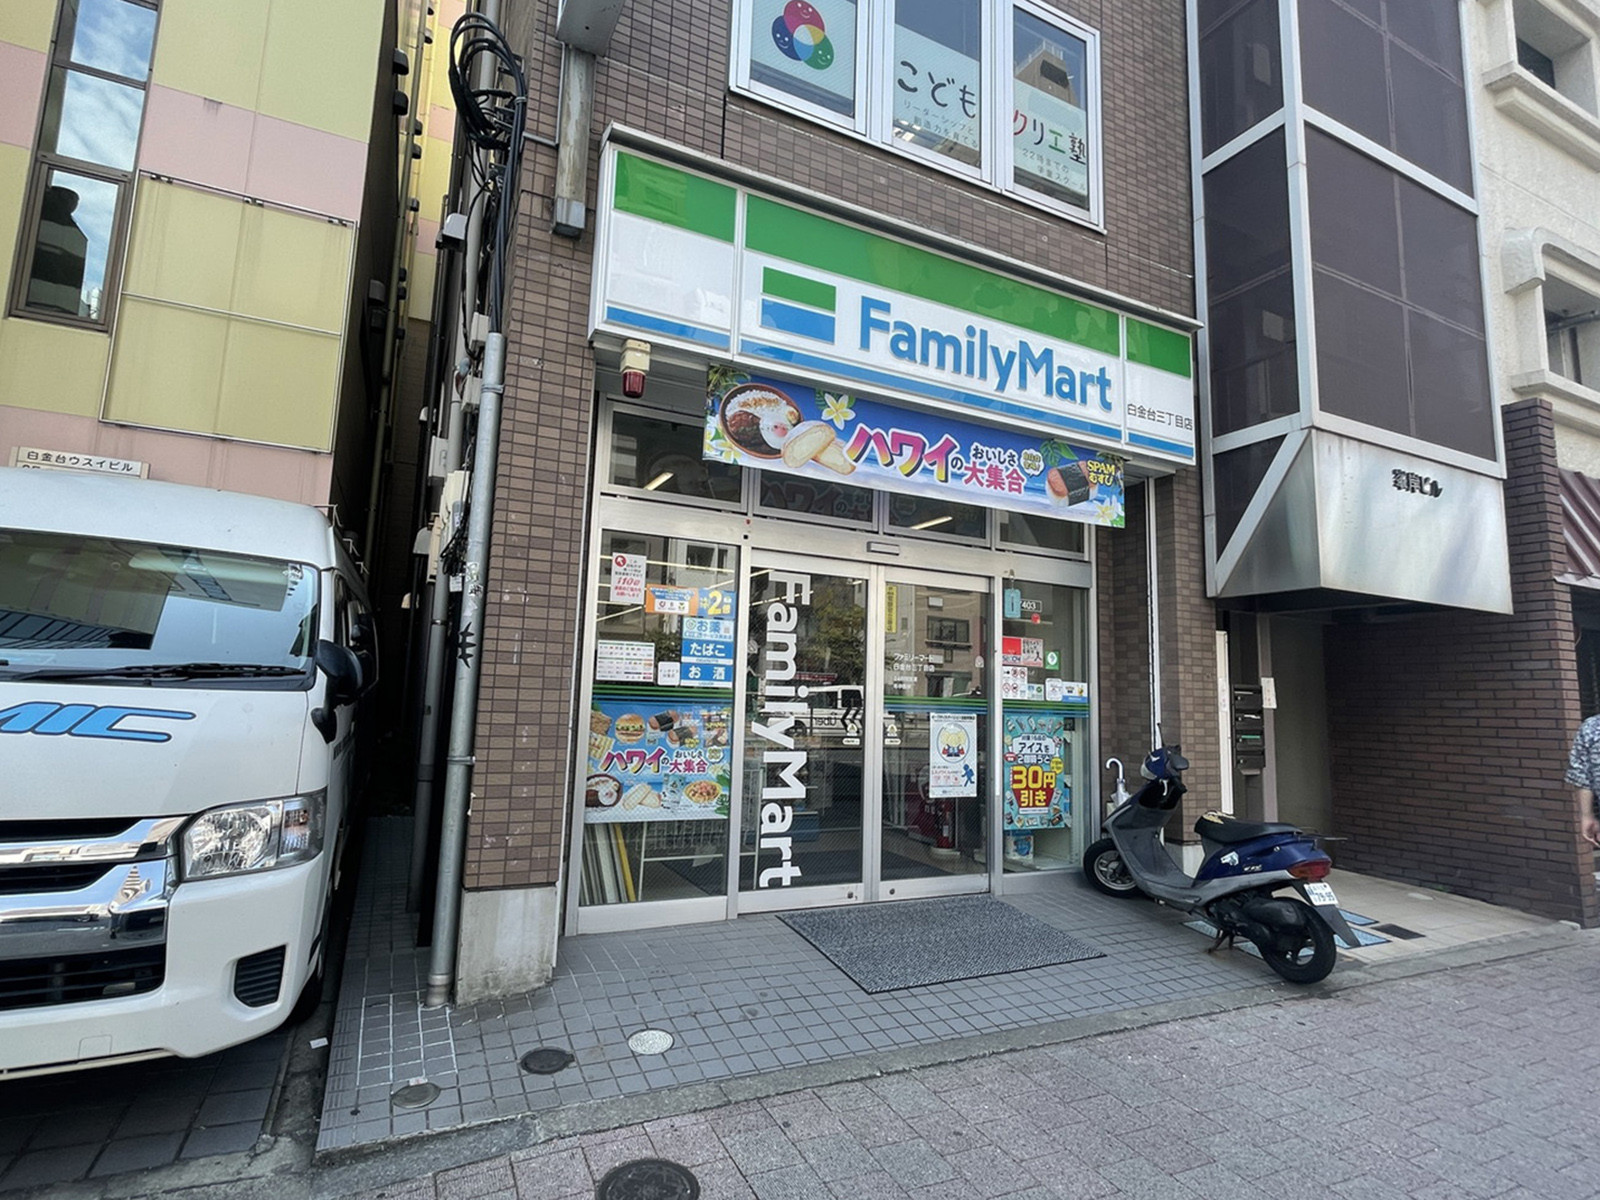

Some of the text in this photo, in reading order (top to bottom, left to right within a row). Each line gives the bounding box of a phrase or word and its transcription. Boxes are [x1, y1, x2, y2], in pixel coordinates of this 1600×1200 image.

[897, 60, 976, 119] こども
[859, 295, 1113, 412] FamilyMart
[1126, 402, 1193, 431] 白金台三丁目店
[26, 450, 133, 472] 白金台ウスイビル
[847, 426, 964, 484] ハワイの
[971, 444, 1017, 465] おいしさ
[963, 461, 1026, 495] 大集合
[1087, 459, 1116, 476] SPAM
[1088, 471, 1114, 486] むすび
[689, 642, 726, 657] たばこ
[688, 665, 726, 680] お酒
[751, 571, 811, 888] FamilyMart
[674, 750, 704, 760] おいしさ
[1018, 742, 1050, 753] アイスを
[600, 747, 670, 774] ハワイの
[669, 758, 709, 773] 大集合
[1012, 765, 1057, 789] 30円
[1020, 789, 1047, 807] 引き
